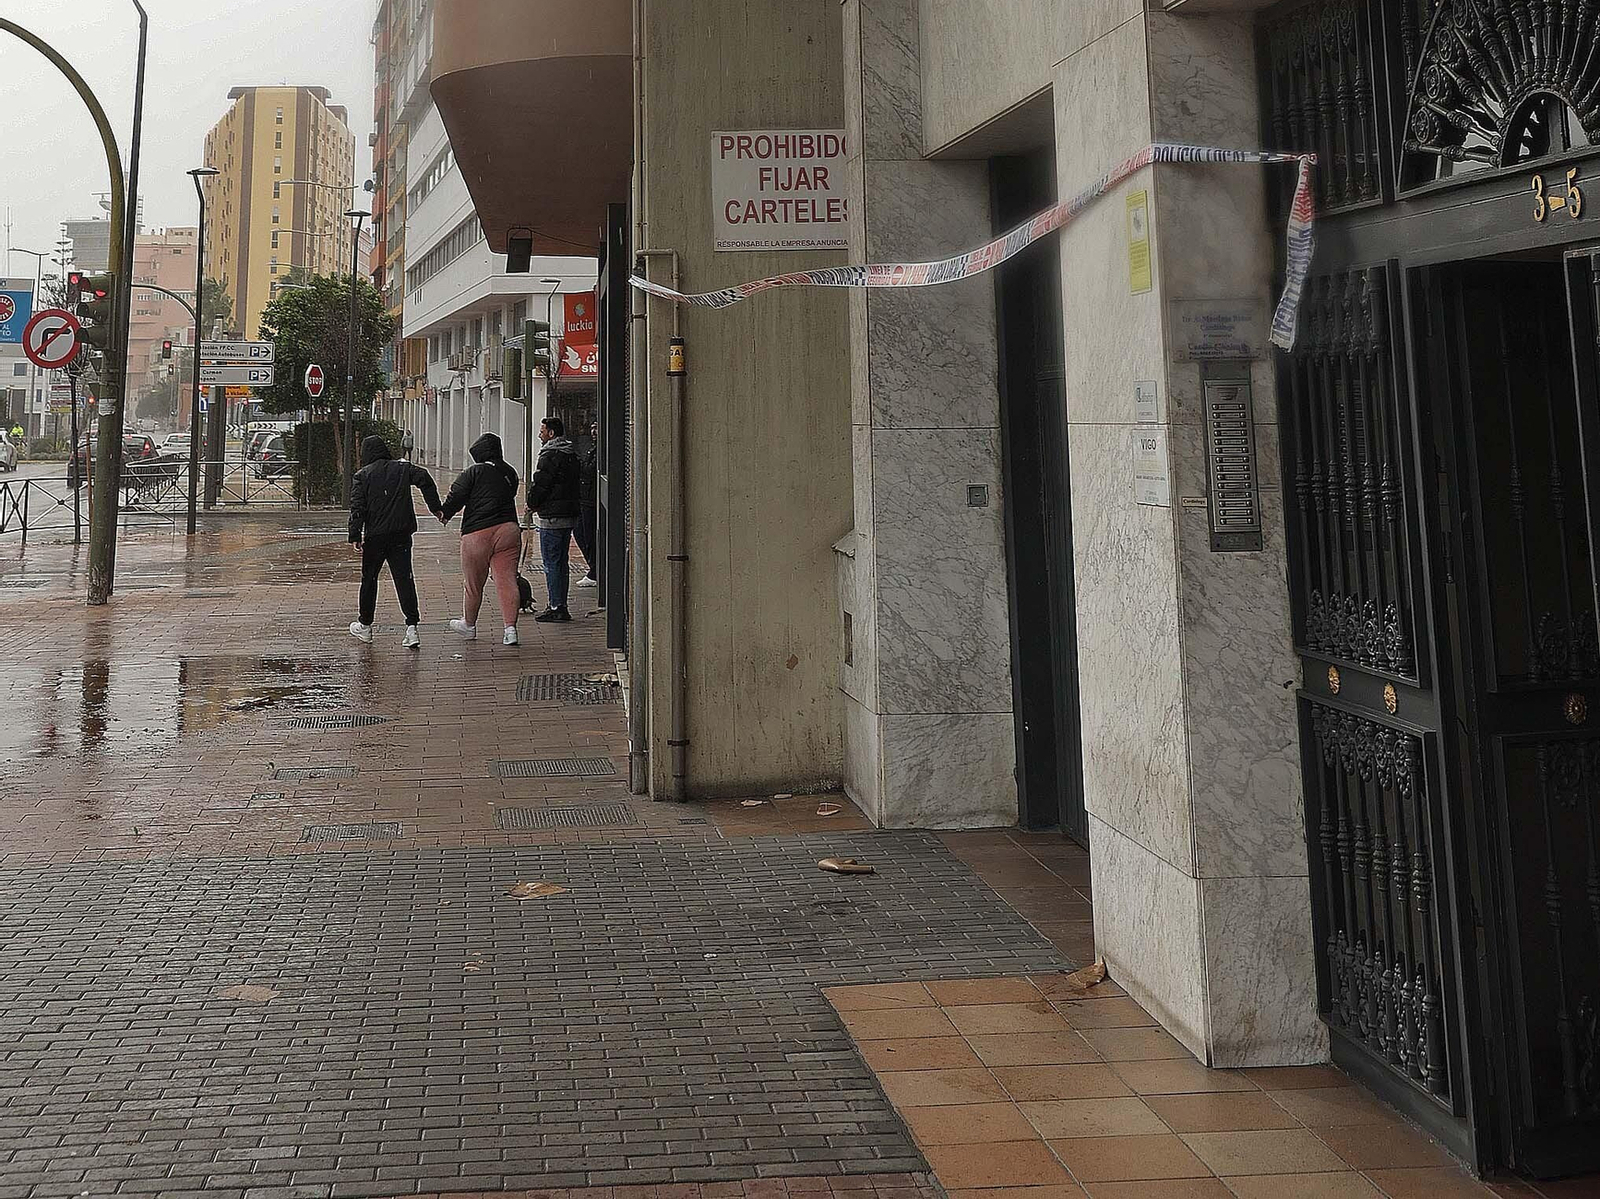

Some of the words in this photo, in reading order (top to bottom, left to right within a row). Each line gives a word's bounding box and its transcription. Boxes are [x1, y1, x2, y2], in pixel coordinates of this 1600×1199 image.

[759, 166, 830, 191] FIJAR
[1531, 167, 1581, 222] 3-5
[717, 240, 769, 248] RESPONSABLE
[781, 239, 815, 247] EMPRESA
[567, 320, 593, 332] luckia
[308, 377, 323, 385] STOP
[1140, 438, 1157, 450] VIGO
